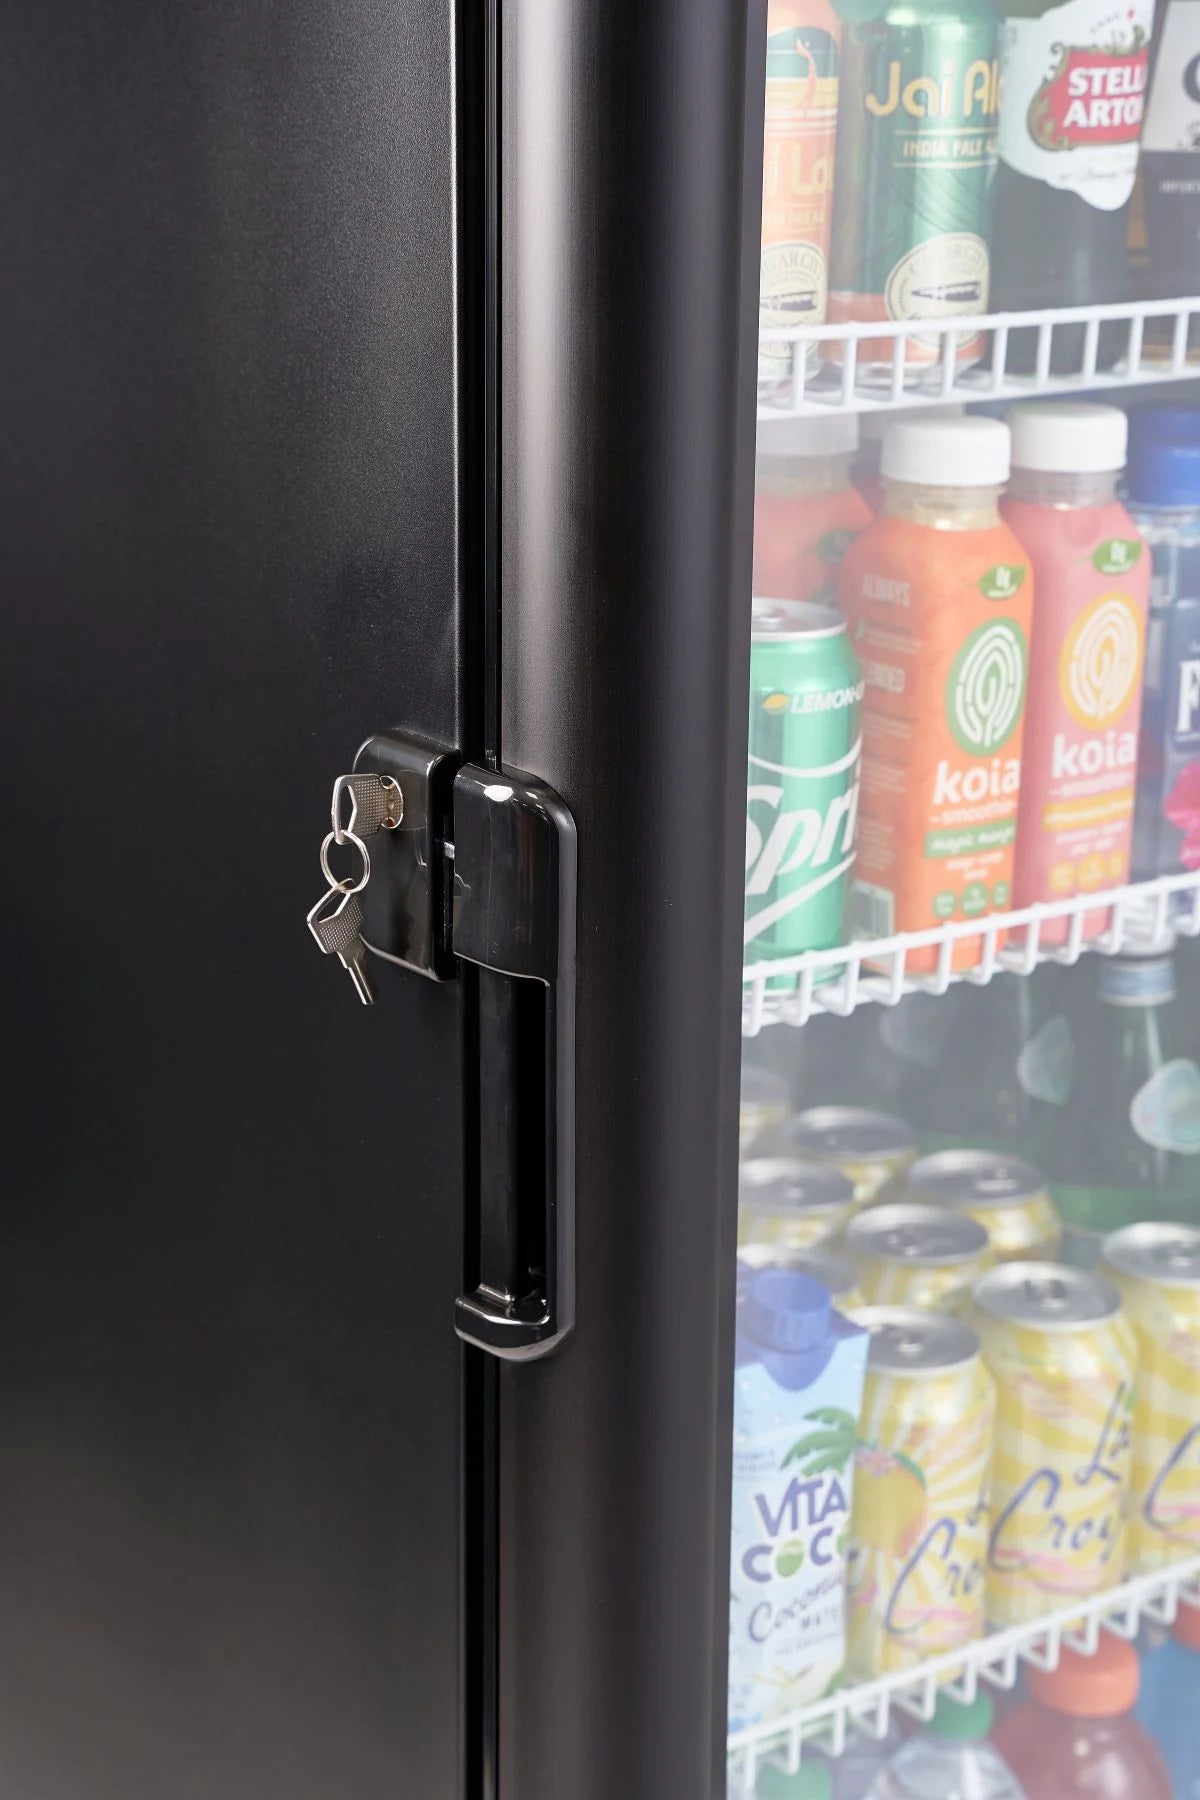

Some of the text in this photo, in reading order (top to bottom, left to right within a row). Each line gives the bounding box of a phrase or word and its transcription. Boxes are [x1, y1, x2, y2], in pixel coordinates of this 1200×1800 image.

[865, 60, 953, 118] Jai
[1067, 65, 1148, 97] STELL
[1063, 96, 1145, 128] ARTO
[903, 140, 948, 157] INDIA
[1052, 730, 1137, 779] koia
[933, 758, 1021, 806] koia
[754, 1477, 847, 1537] VITA
